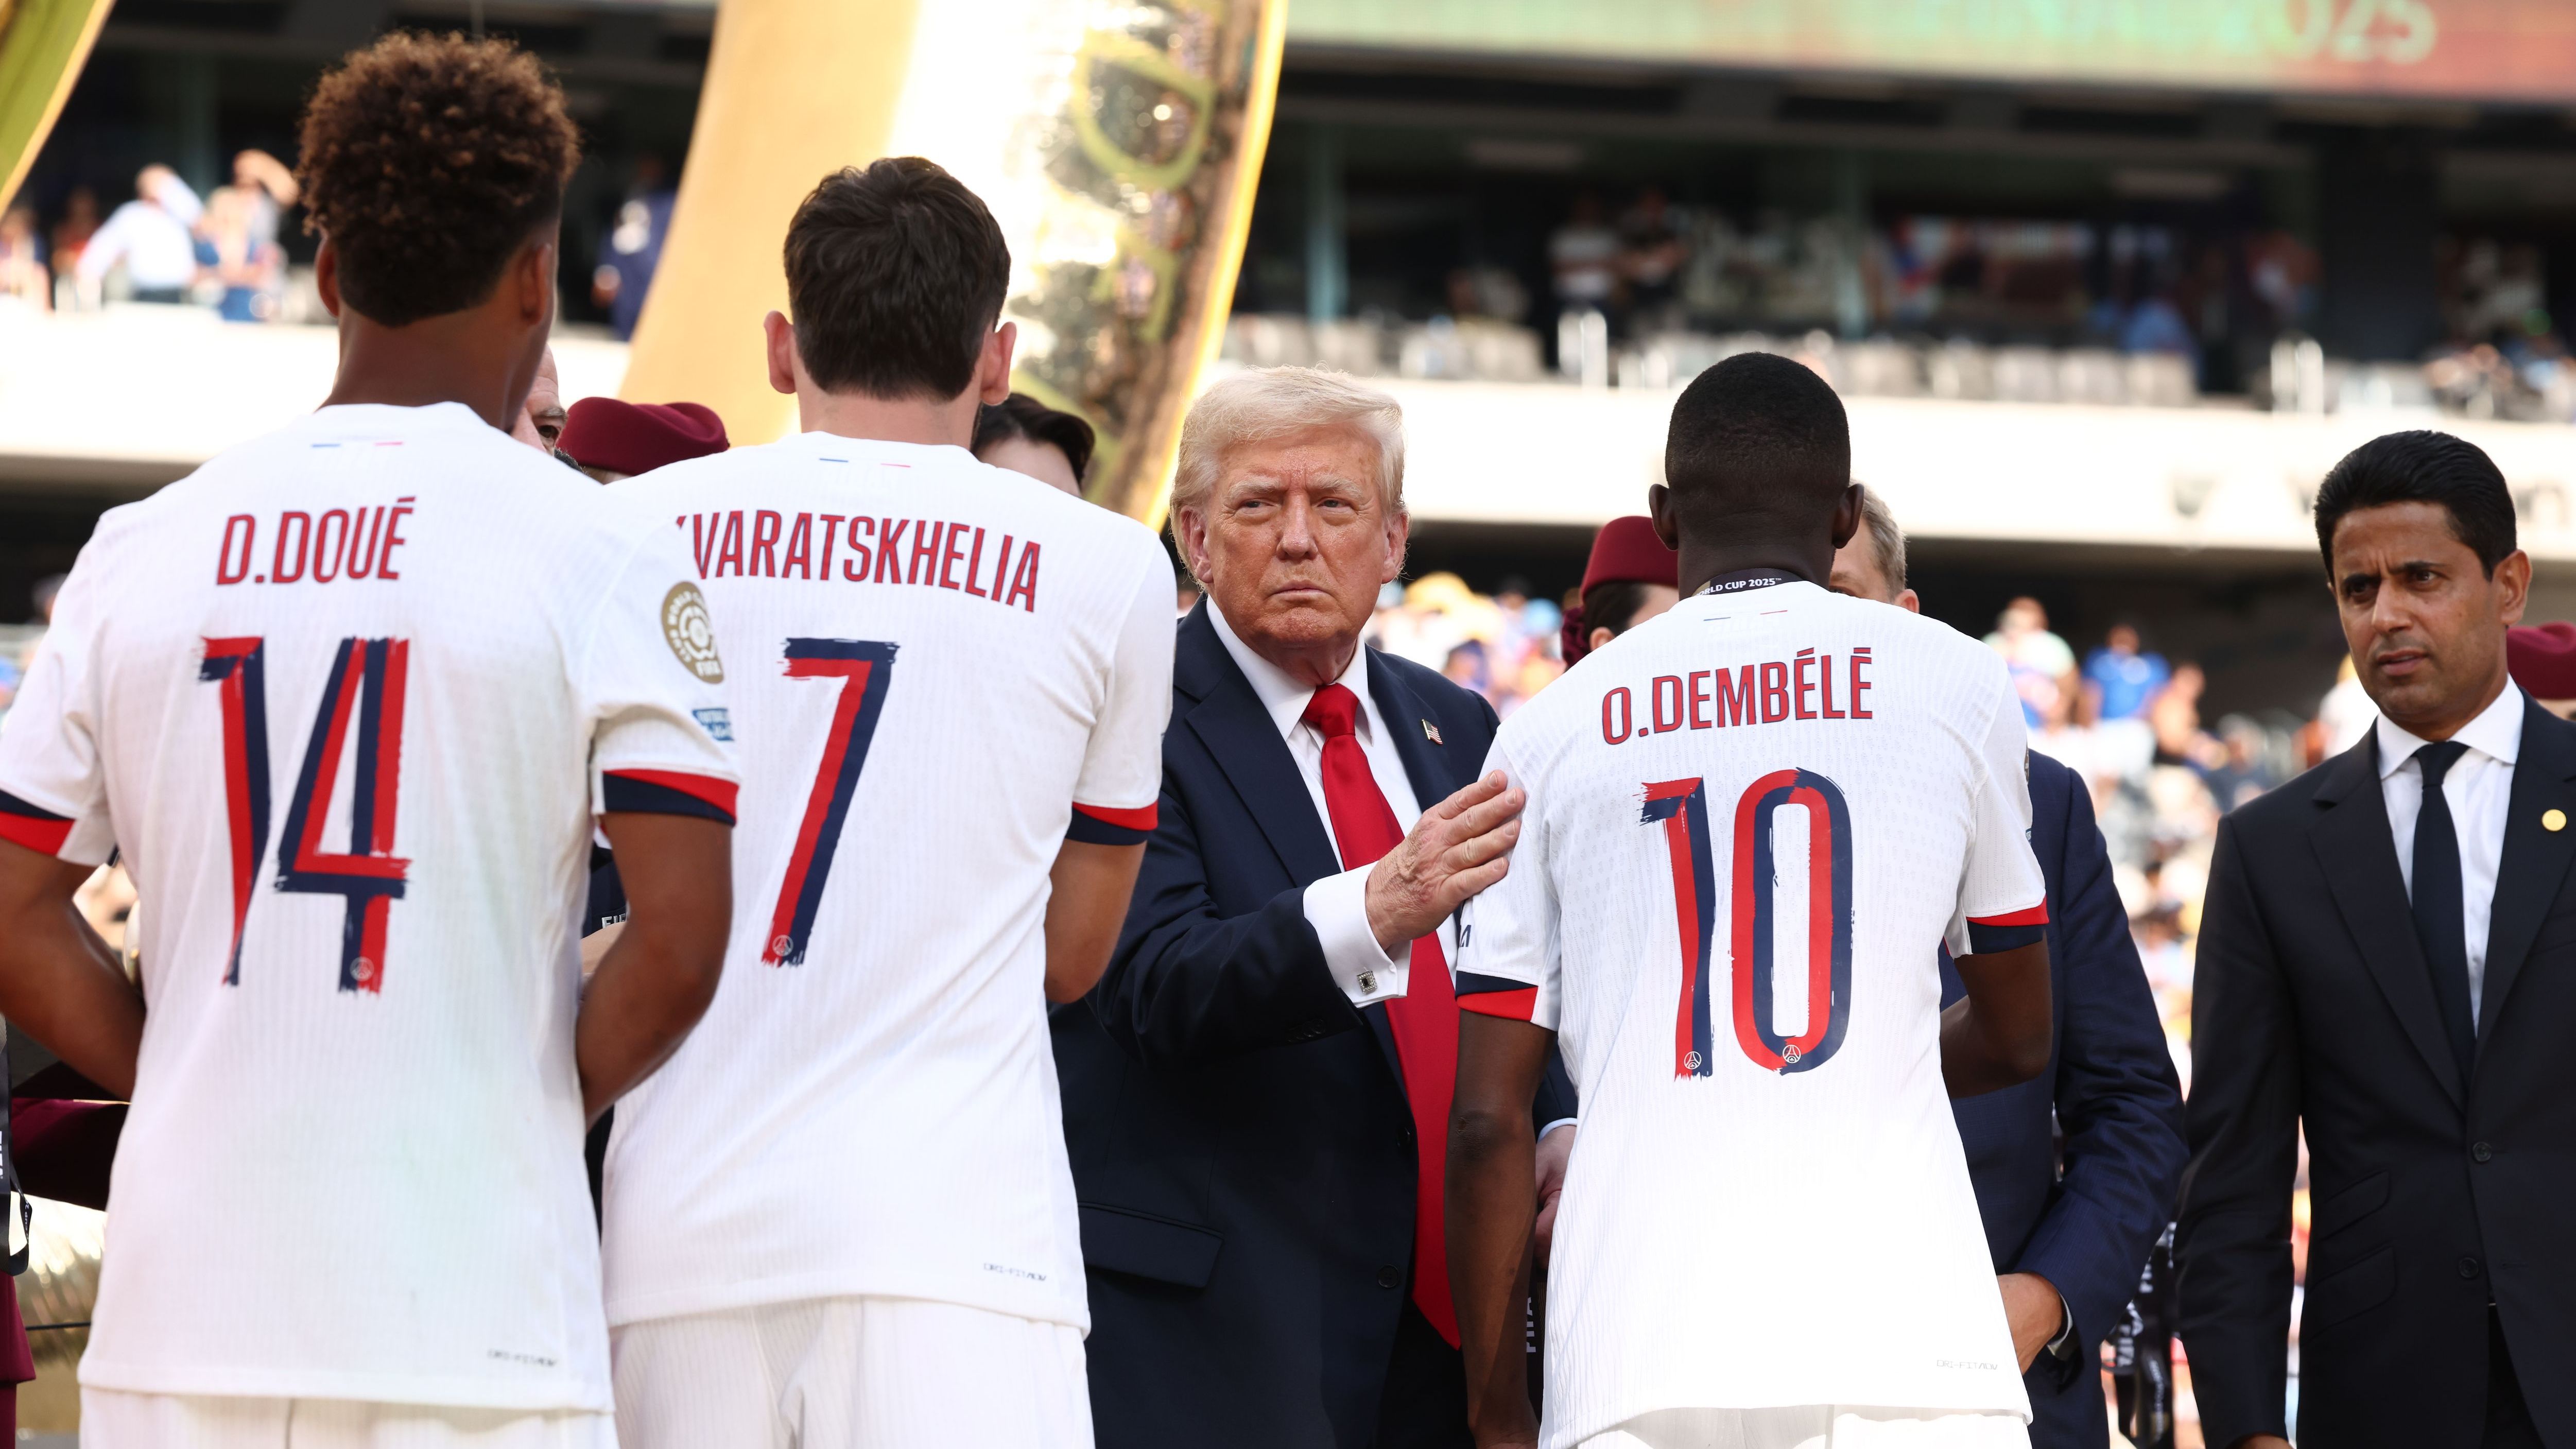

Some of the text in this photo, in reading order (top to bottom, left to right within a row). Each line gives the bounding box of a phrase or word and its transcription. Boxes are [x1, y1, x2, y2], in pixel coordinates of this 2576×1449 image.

[216, 496, 416, 585] D.DOUÉ
[677, 510, 1041, 613] VARATSKHELIA
[1696, 585, 1723, 596] ORLD
[1725, 581, 1747, 590] CUP
[1602, 647, 1873, 746] O.DEMBÉLÉ
[198, 636, 412, 999] 14
[760, 637, 901, 968] 7
[1633, 767, 1854, 1081] 10
